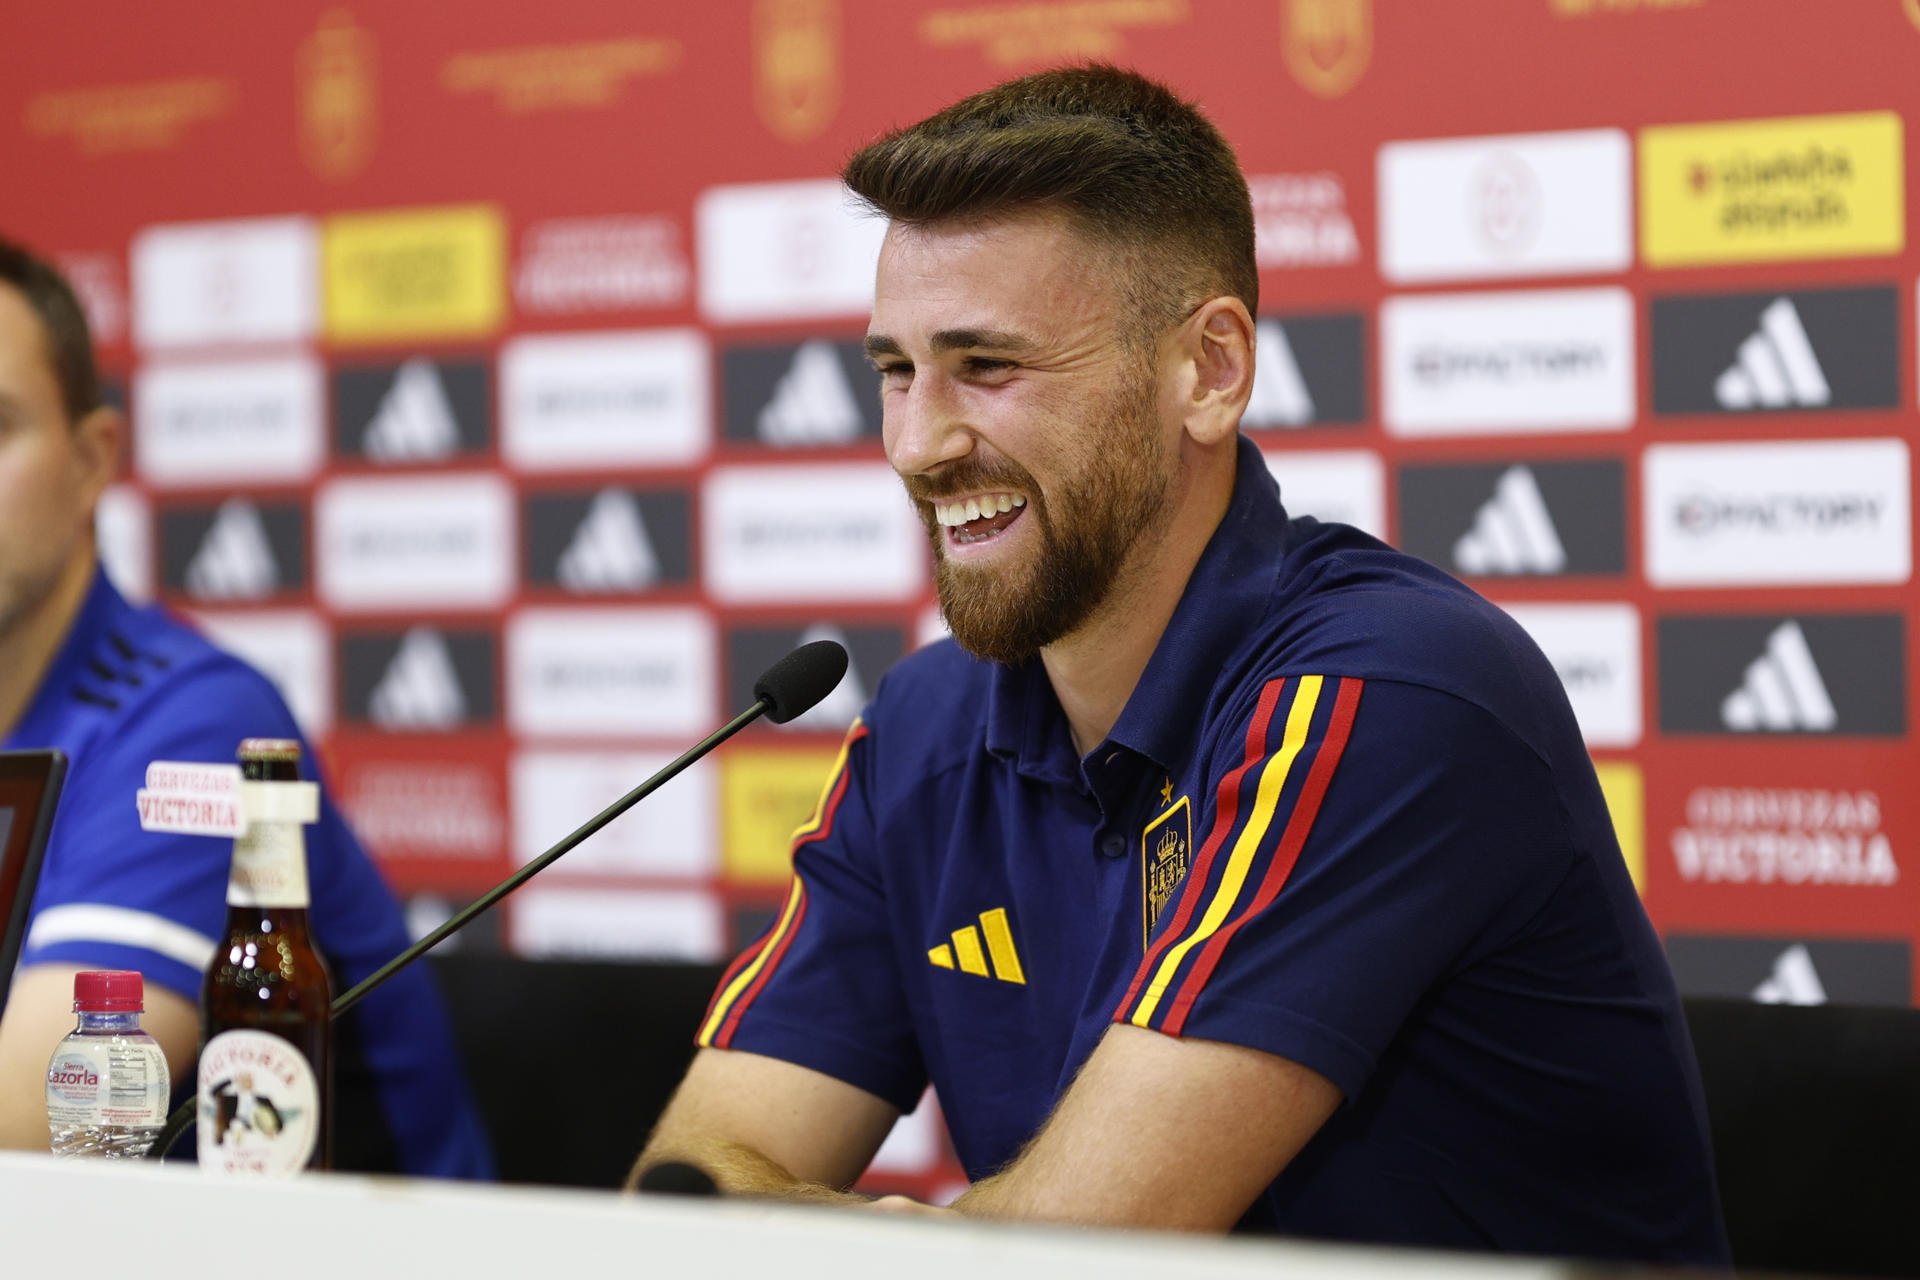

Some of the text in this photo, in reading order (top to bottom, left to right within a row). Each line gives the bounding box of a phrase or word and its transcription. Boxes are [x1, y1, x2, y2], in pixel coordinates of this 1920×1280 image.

[147, 769, 232, 793] CERVEZAS
[140, 796, 239, 829] VICTORIA
[1685, 786, 1881, 832] CERVEZAS
[1669, 827, 1900, 886] VICTORIA
[63, 1061, 85, 1071] Sierra
